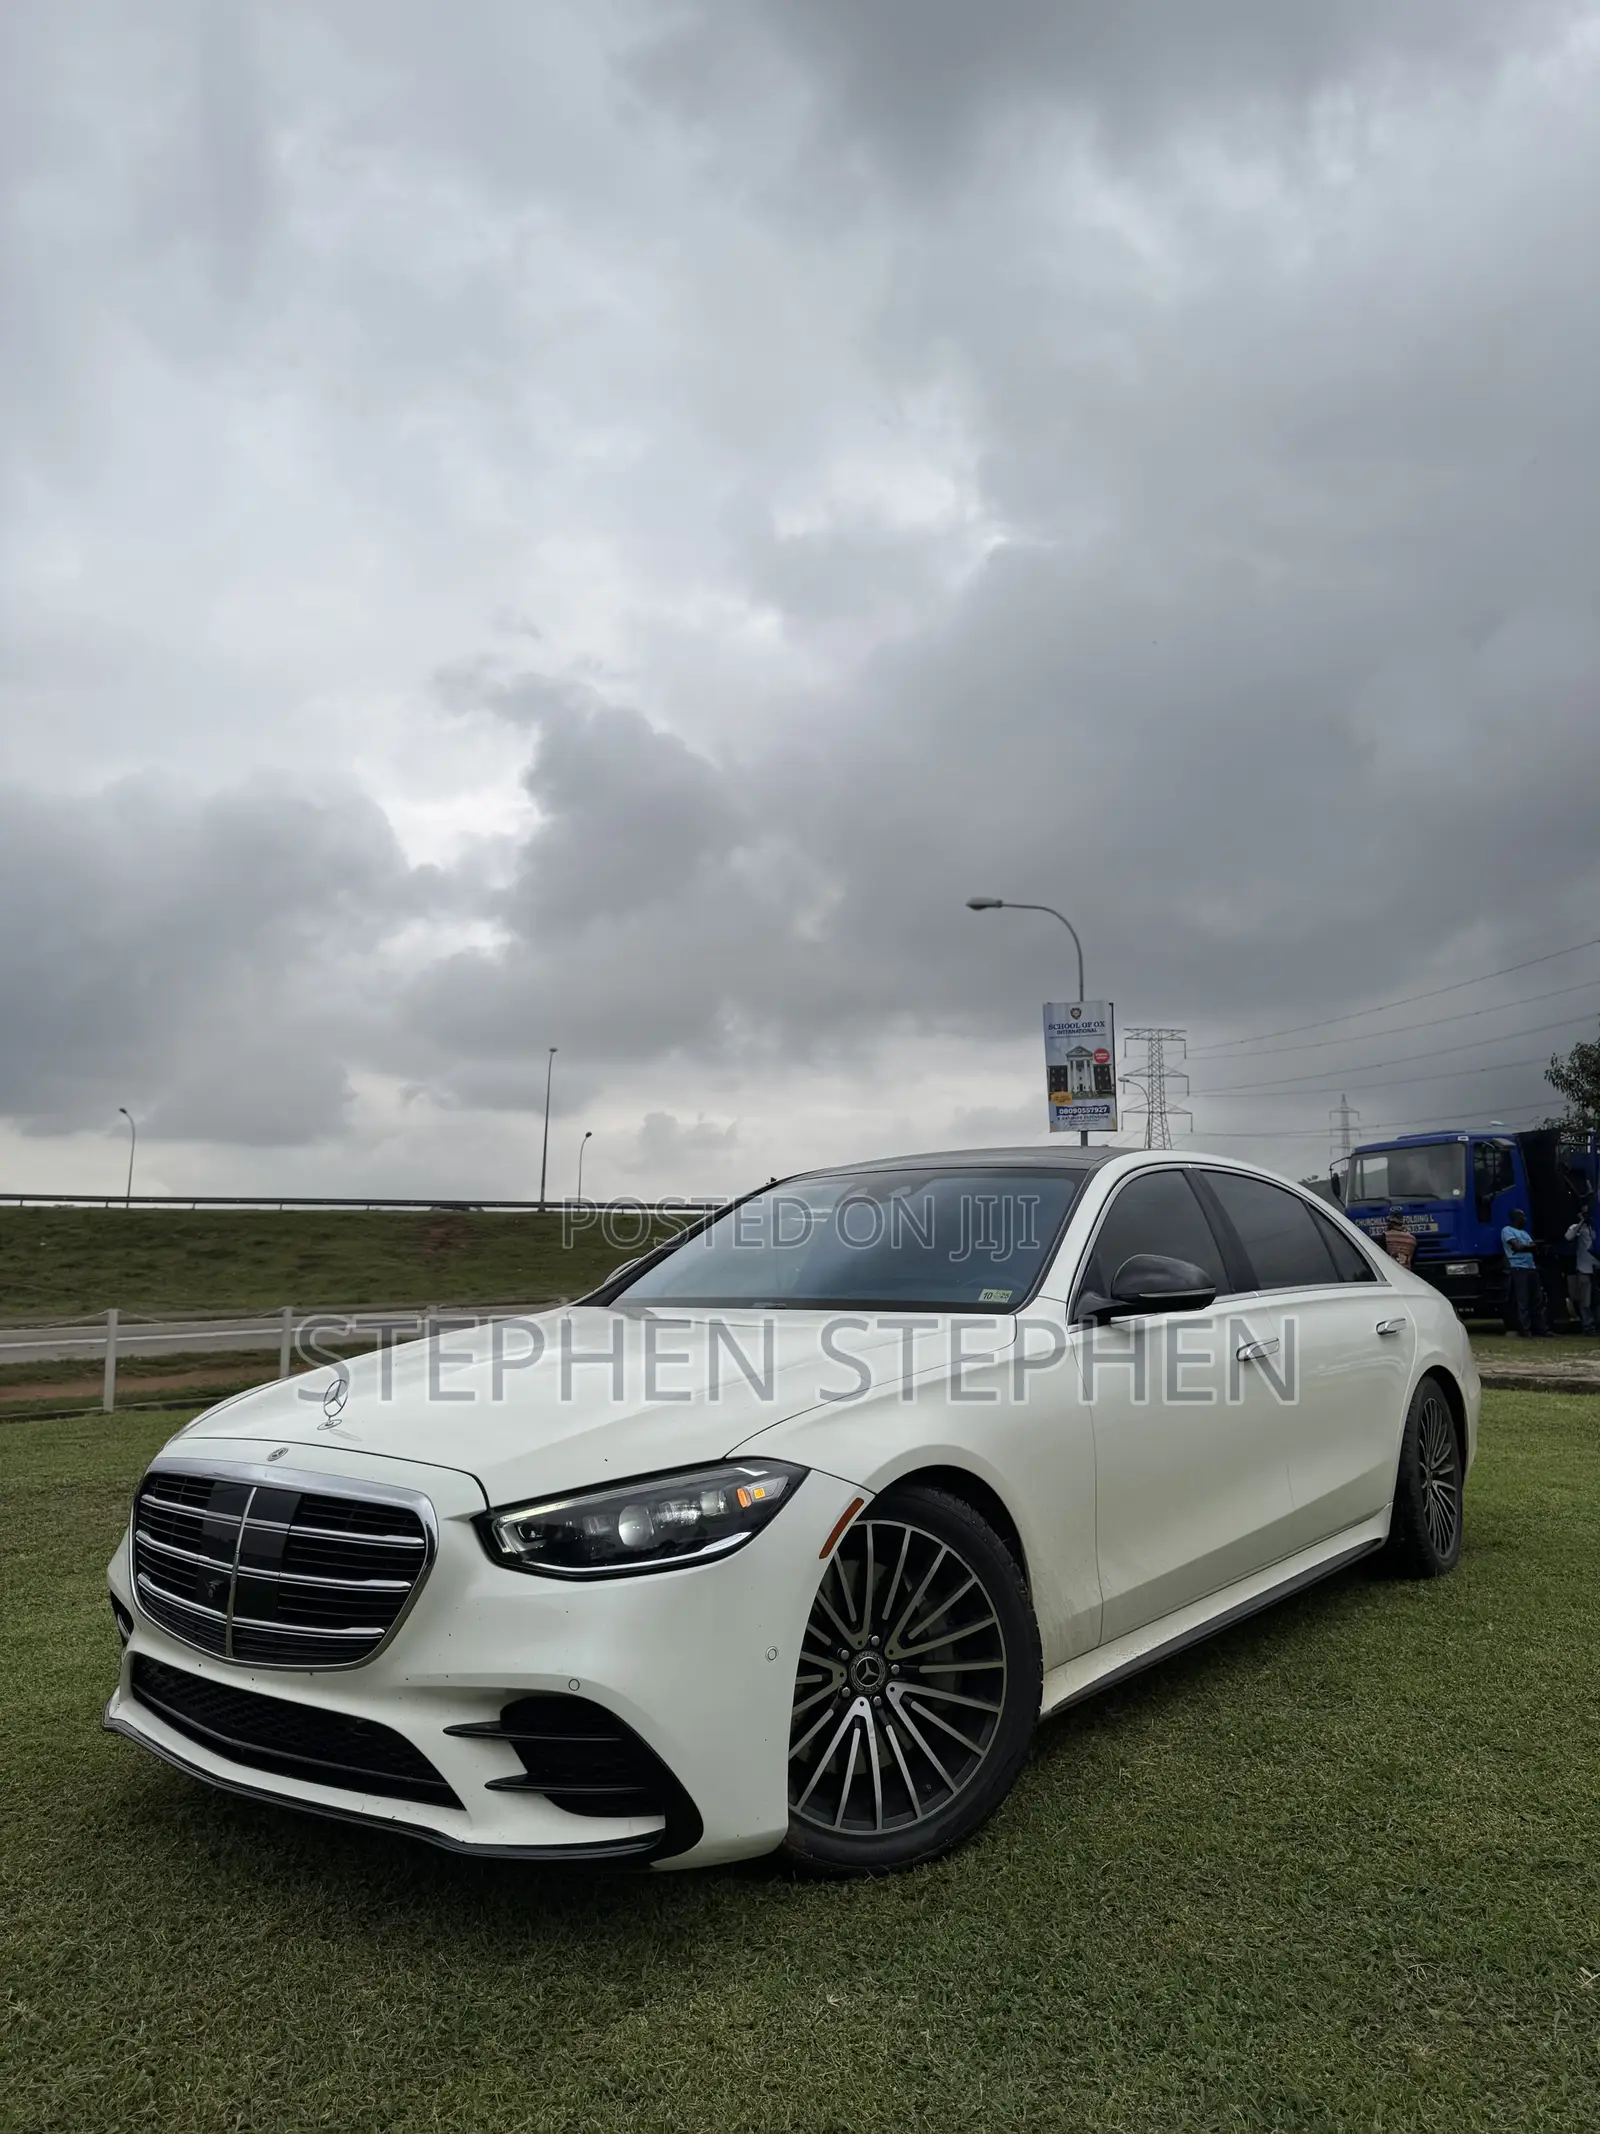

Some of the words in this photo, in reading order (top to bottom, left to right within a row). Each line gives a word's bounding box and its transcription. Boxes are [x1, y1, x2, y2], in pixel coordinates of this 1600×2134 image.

[1048, 1022, 1081, 1031] SCHOOL
[1082, 1021, 1093, 1029] OF
[1094, 1020, 1105, 1028] OX
